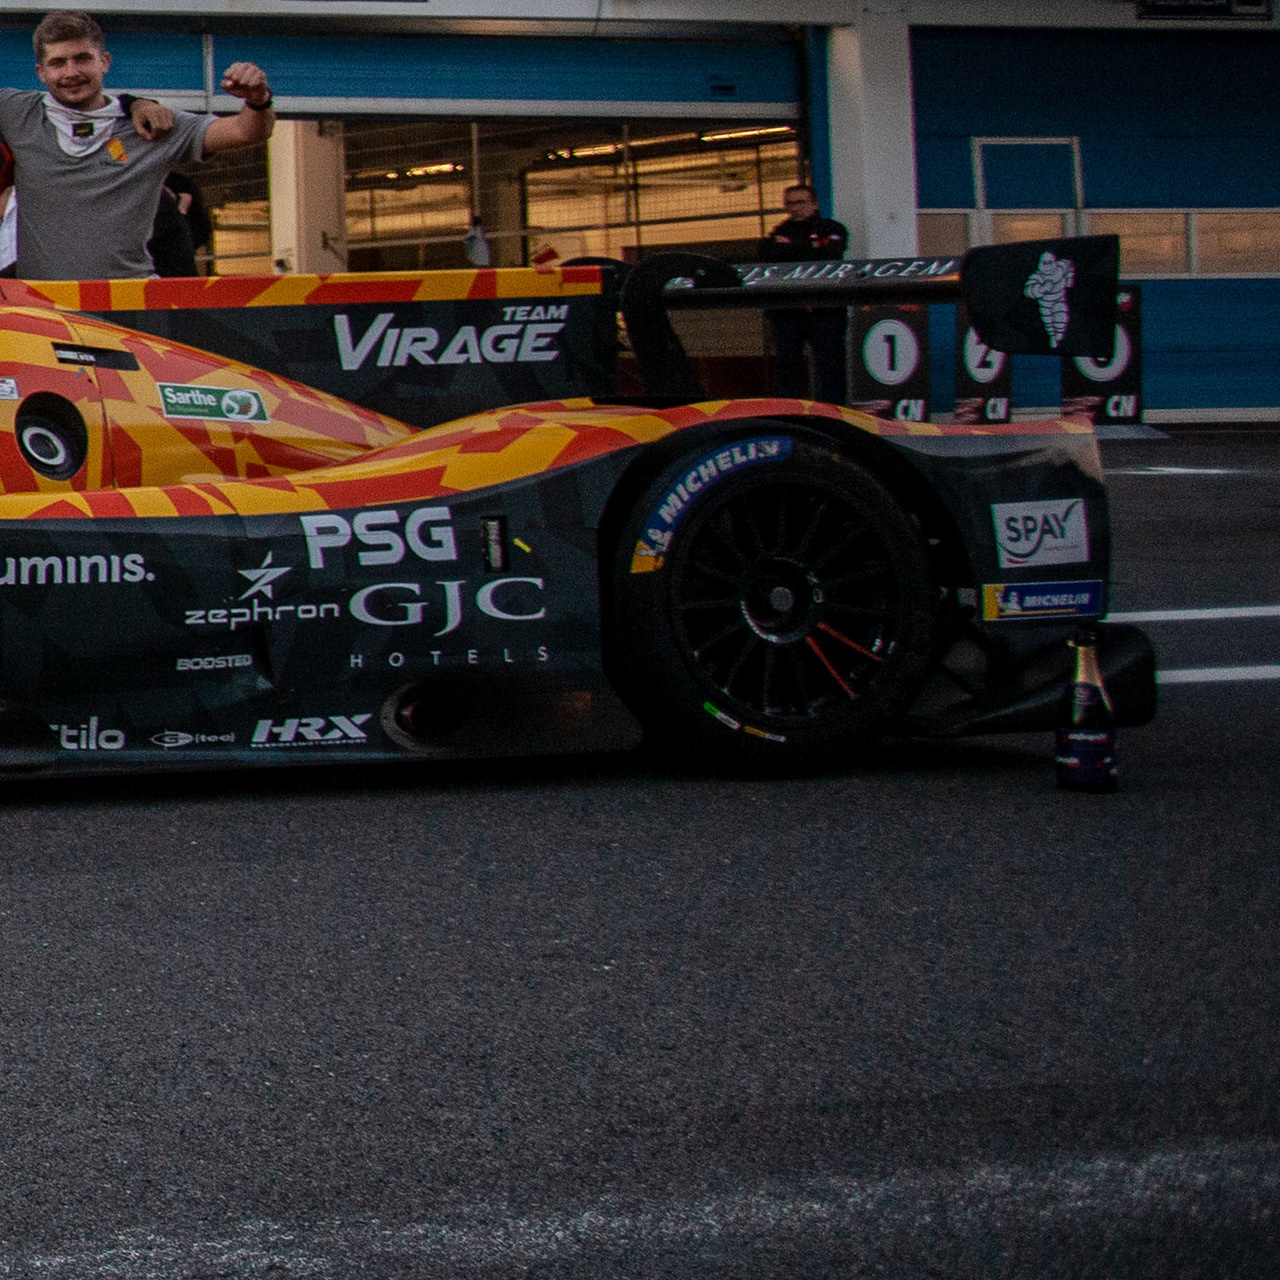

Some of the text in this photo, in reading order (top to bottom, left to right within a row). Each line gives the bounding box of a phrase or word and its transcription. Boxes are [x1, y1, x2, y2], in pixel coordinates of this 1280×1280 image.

[783, 259, 956, 282] MIRAGEM
[502, 304, 570, 321] TEAM
[333, 312, 566, 371] VIRAGE
[882, 334, 897, 372] 1
[164, 387, 218, 406] Sarthe
[658, 440, 781, 525] MICHELIN
[300, 506, 458, 569] PSG
[1005, 513, 1068, 543] SPAY
[184, 598, 341, 631] zephron
[349, 576, 549, 638] GJC
[1022, 592, 1092, 608] MICHELIN
[350, 646, 550, 668] HOTELS
[49, 715, 126, 751] tilo
[250, 713, 374, 744] HRX
